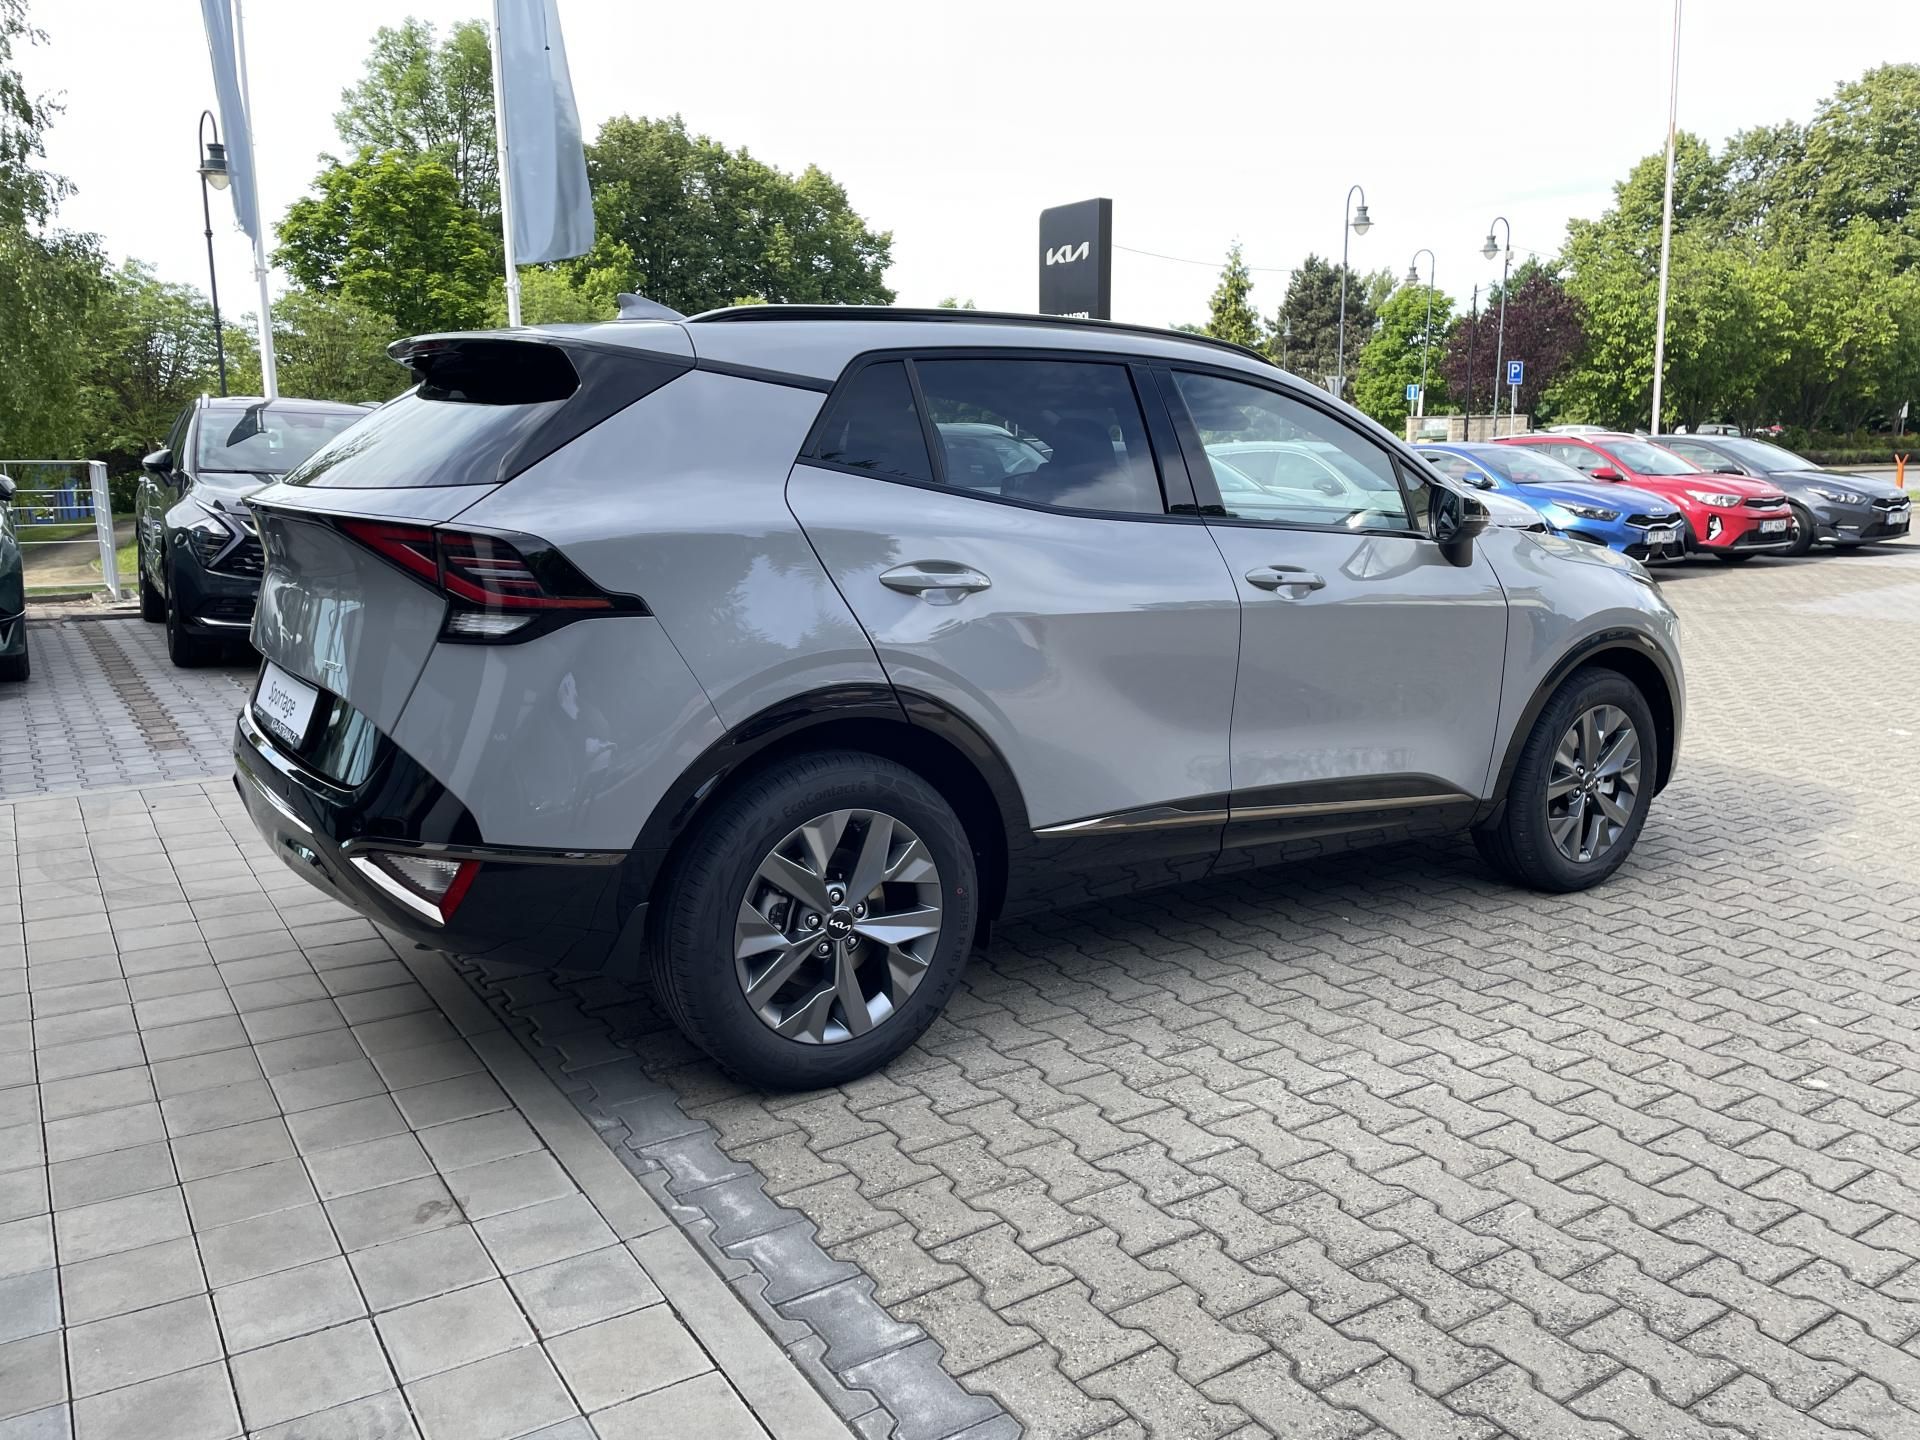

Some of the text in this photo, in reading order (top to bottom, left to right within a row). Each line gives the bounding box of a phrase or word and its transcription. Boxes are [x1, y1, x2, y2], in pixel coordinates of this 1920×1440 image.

[1046, 241, 1090, 266] KIA
[1511, 363, 1520, 378] P
[268, 680, 296, 719] Sportage
[829, 919, 852, 931] KIA
